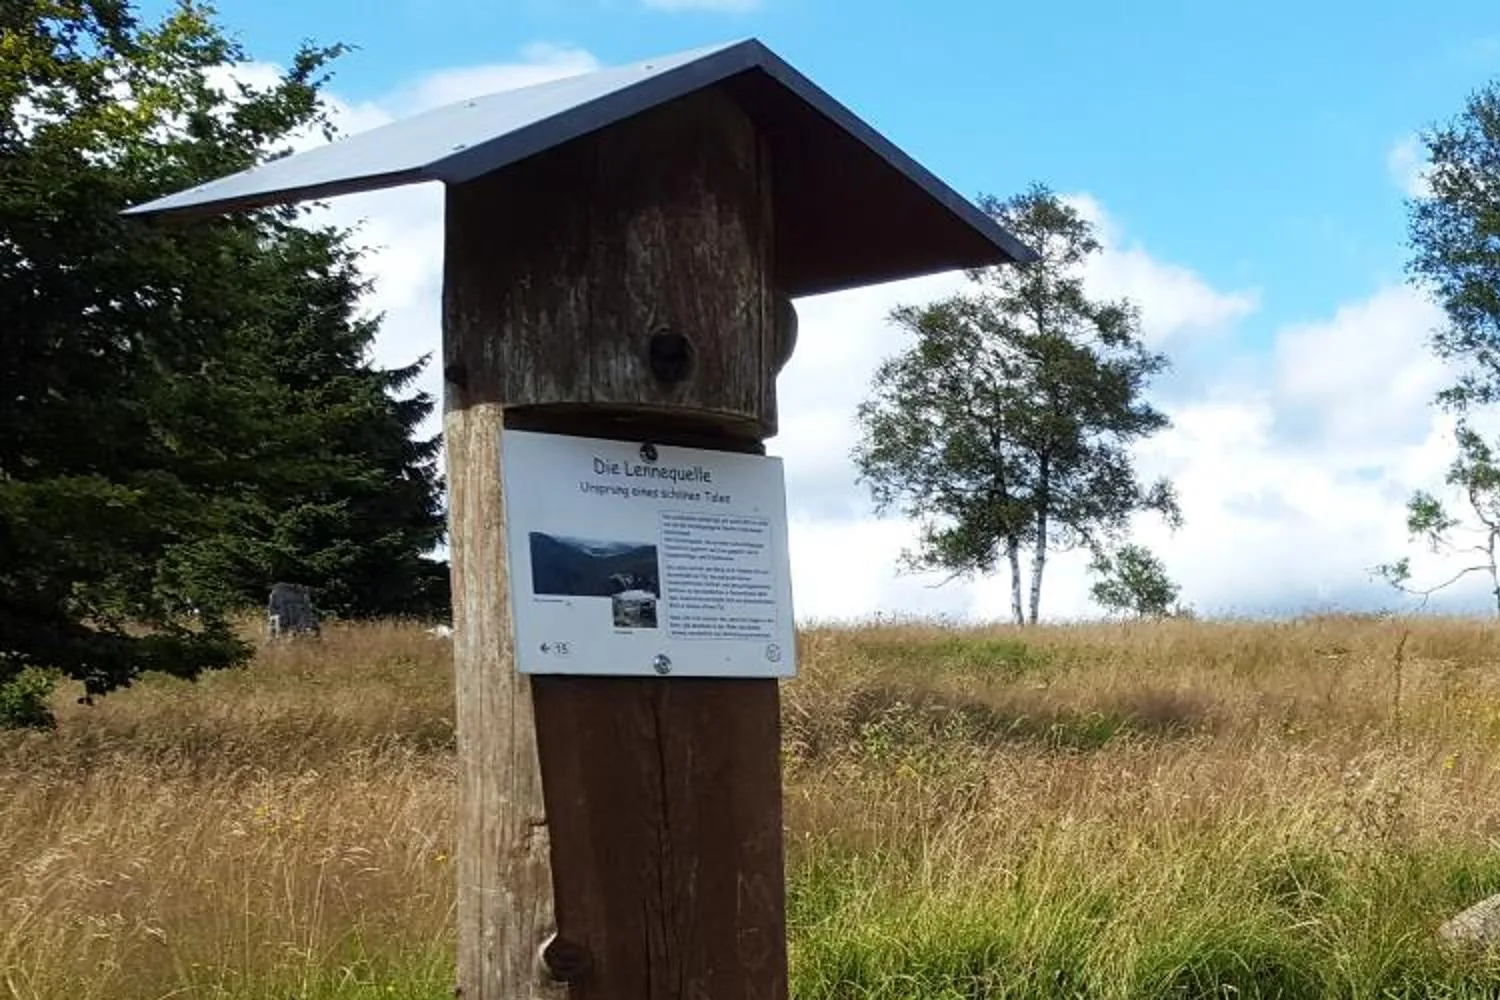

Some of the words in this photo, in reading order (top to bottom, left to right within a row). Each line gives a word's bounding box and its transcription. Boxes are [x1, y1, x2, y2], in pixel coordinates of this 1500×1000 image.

[594, 456, 620, 475] Die
[624, 461, 712, 484] Lennequelle
[579, 481, 629, 498] Ursprung
